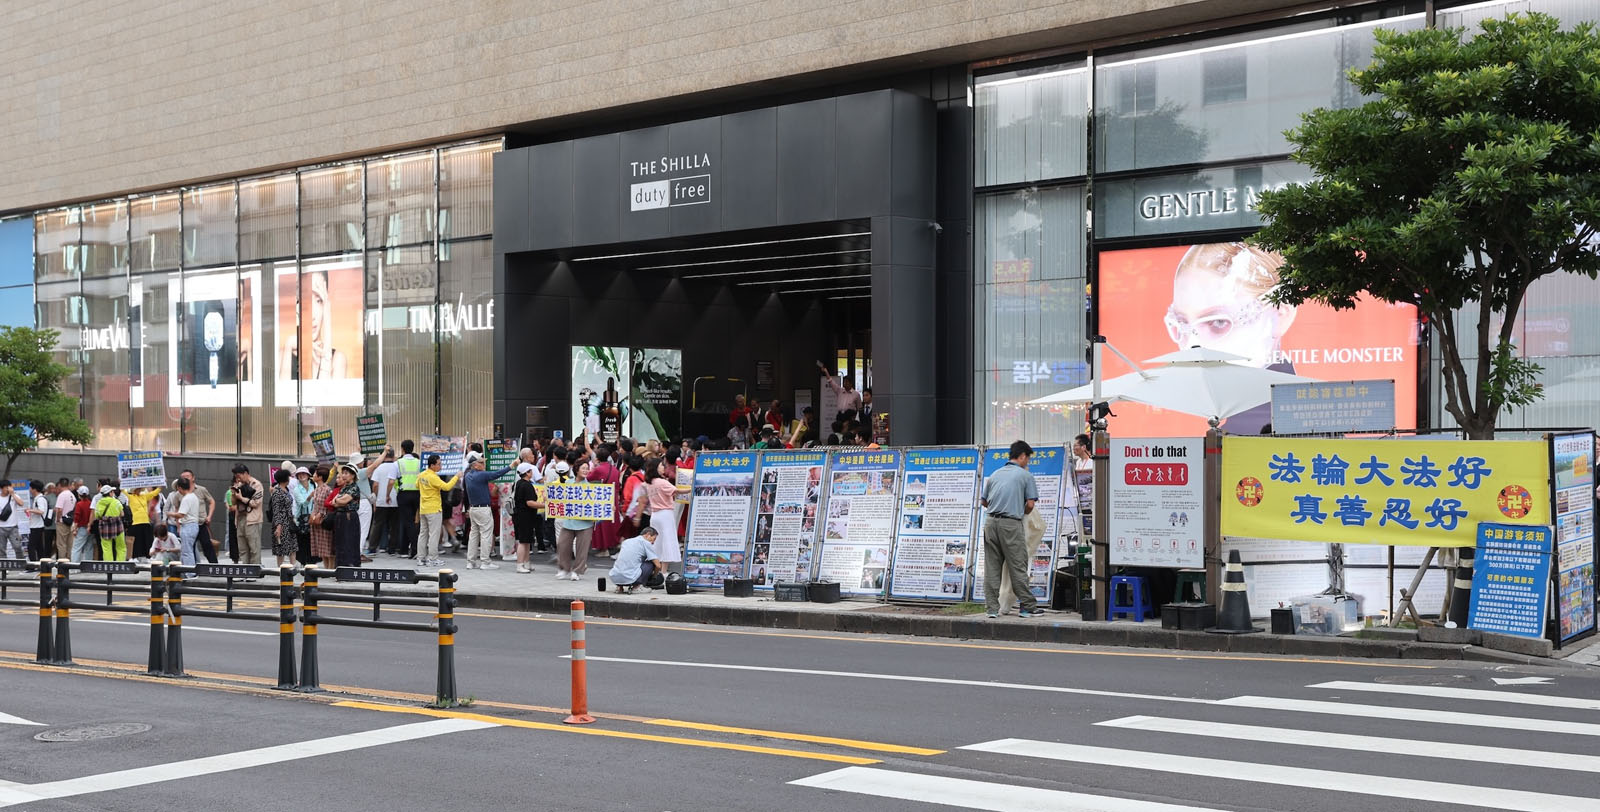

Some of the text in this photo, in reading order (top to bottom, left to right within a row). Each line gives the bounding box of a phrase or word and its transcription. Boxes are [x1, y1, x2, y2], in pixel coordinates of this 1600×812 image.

[630, 152, 710, 176] THE SHILLA
[635, 182, 704, 206] duty free
[1139, 187, 1237, 220] GENTLE
[1323, 346, 1404, 364] MONSTER
[1124, 445, 1187, 458] Don't do that
[1268, 452, 1492, 490] 法輪大法好
[547, 485, 612, 500] 诚念法轮大法好
[547, 502, 612, 518] 危难来时命能保
[1290, 493, 1468, 530] 真善忍好
[1485, 528, 1545, 542] 中国游客须知
[353, 571, 399, 580] 무단횡단금지
